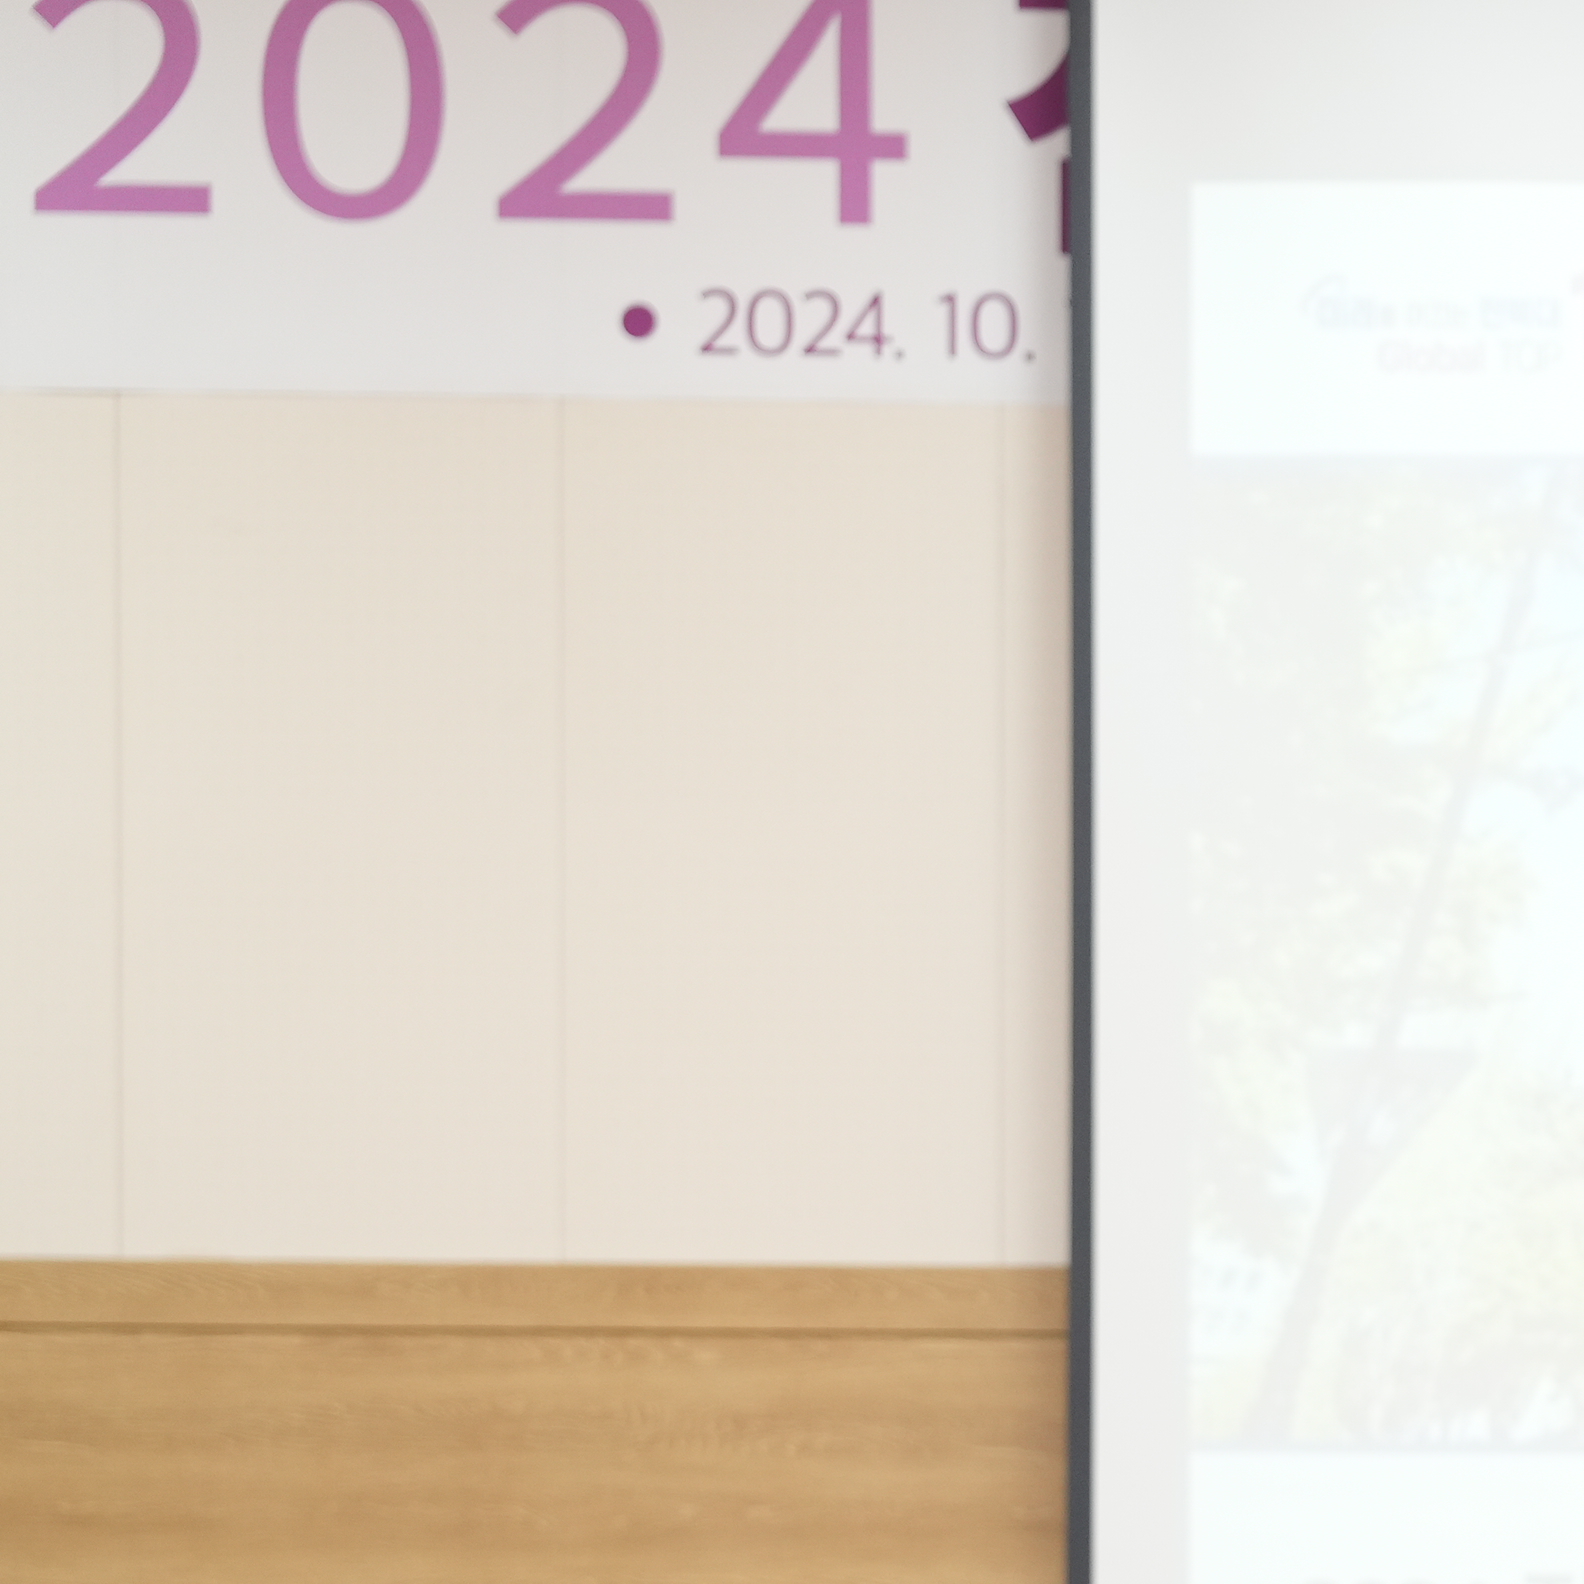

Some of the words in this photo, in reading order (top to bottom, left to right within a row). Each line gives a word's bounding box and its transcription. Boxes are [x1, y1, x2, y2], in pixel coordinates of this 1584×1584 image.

[32, 0, 908, 225] 2024
[698, 290, 904, 359] 2024.
[940, 293, 1036, 361] 10.
